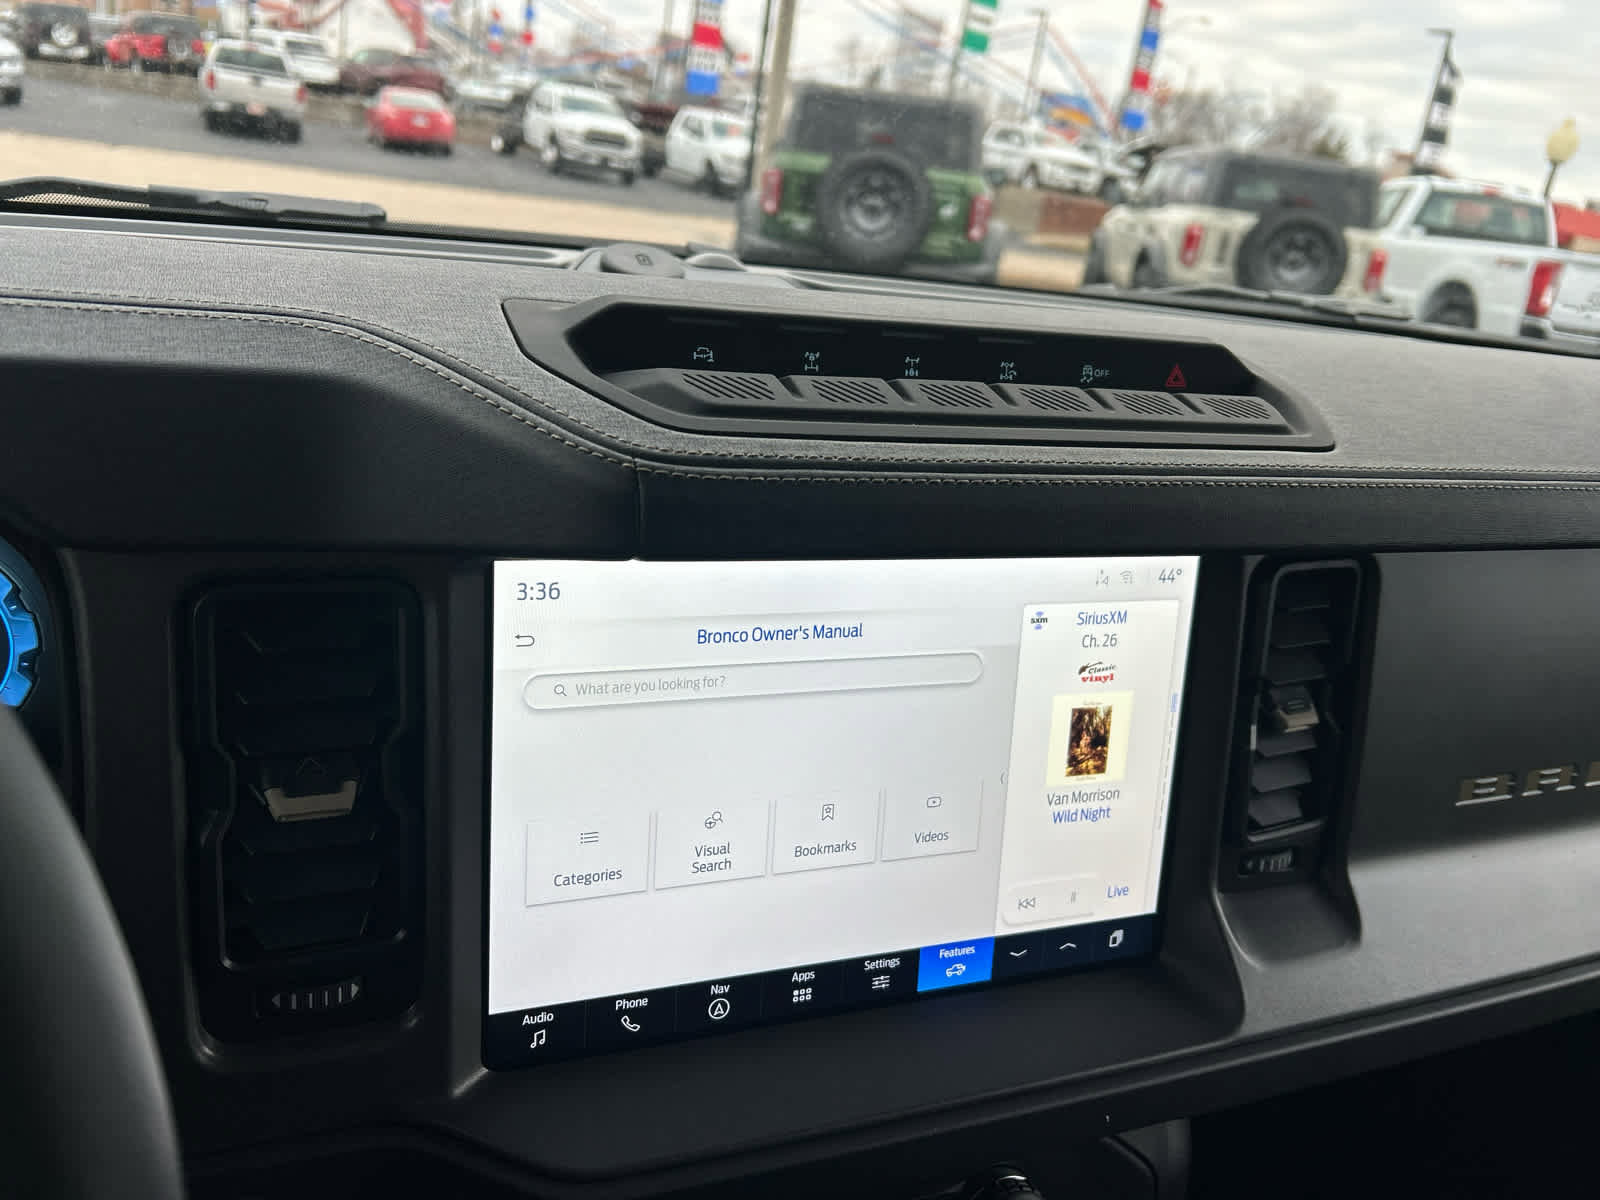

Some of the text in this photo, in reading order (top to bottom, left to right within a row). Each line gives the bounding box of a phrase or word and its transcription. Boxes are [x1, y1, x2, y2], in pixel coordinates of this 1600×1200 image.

[1094, 369, 1110, 377] OFF
[516, 582, 561, 601] 3:36
[1076, 610, 1128, 626] SiriusXM
[697, 622, 864, 645] Bronco Owner's Manual
[1081, 633, 1118, 648] Ch. 26
[1087, 663, 1117, 675] Classic
[575, 675, 727, 697] What are you looking for?
[1047, 788, 1121, 807] Van Morrison
[1052, 806, 1111, 824] Wild Night
[914, 829, 949, 844] Videos
[694, 841, 731, 857] Visual
[794, 839, 857, 858] Bookmarks
[691, 857, 732, 874] Search
[553, 867, 623, 888] Categories
[1107, 885, 1129, 899] Live
[939, 944, 976, 959] Features
[864, 956, 900, 971] Settings
[791, 970, 816, 983] Apps
[710, 983, 730, 995] Nav
[615, 996, 649, 1010] Phone
[522, 1011, 554, 1026] Audio
